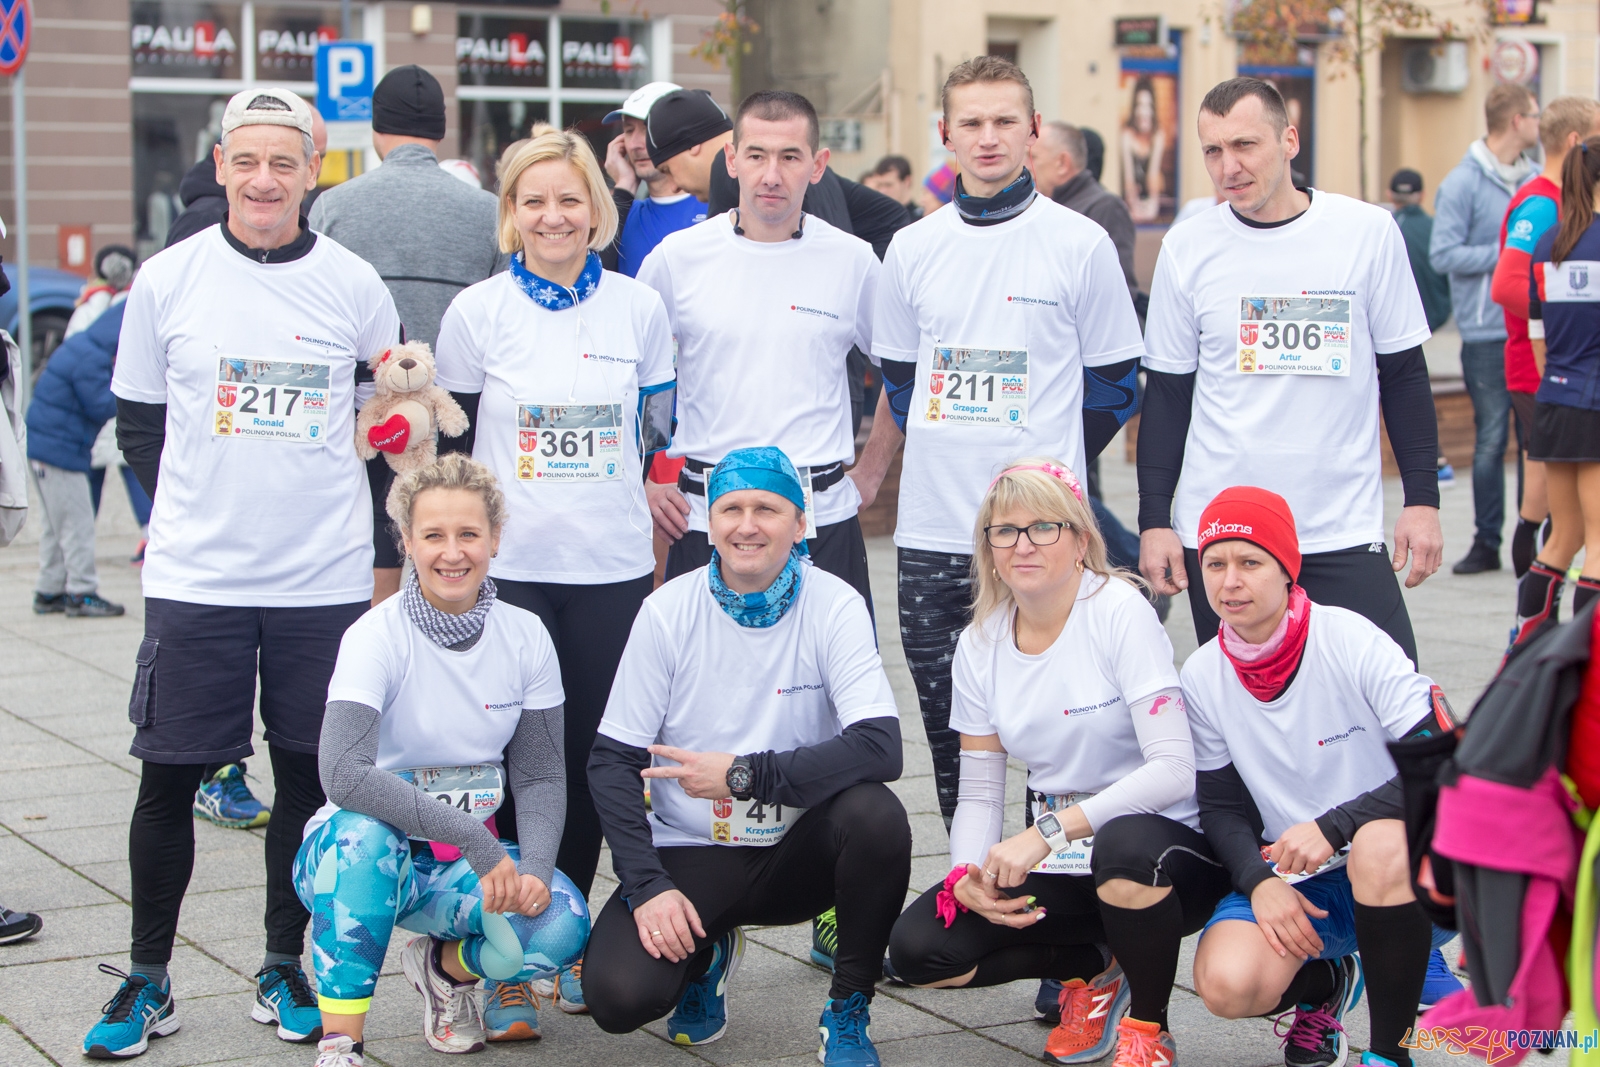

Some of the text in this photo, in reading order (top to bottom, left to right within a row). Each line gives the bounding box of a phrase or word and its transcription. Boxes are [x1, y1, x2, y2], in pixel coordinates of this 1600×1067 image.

[132, 24, 236, 52] PAULA
[258, 29, 331, 54] PAU
[456, 37, 545, 63] PAULA
[563, 41, 648, 66] PAULA
[797, 306, 822, 315] POLINOVA
[823, 311, 839, 320] POLSKA
[302, 337, 331, 346] POLINOVA
[1262, 322, 1321, 350] 306
[589, 354, 615, 362] POINOVA
[1279, 353, 1301, 361] Artur
[946, 373, 994, 401] 211
[239, 386, 302, 416] 217
[953, 404, 988, 413] Grzegorz
[253, 417, 284, 427] Ronald
[276, 430, 300, 438] POLSKA
[391, 429, 405, 442] you
[540, 430, 593, 457] 361
[547, 461, 589, 470] Katarzyna
[1069, 705, 1098, 714] POLINOVA
[1099, 696, 1121, 708] POLSKA
[1324, 732, 1349, 744] POLINVA
[746, 799, 781, 823] 41
[746, 824, 786, 836] Krzysztof
